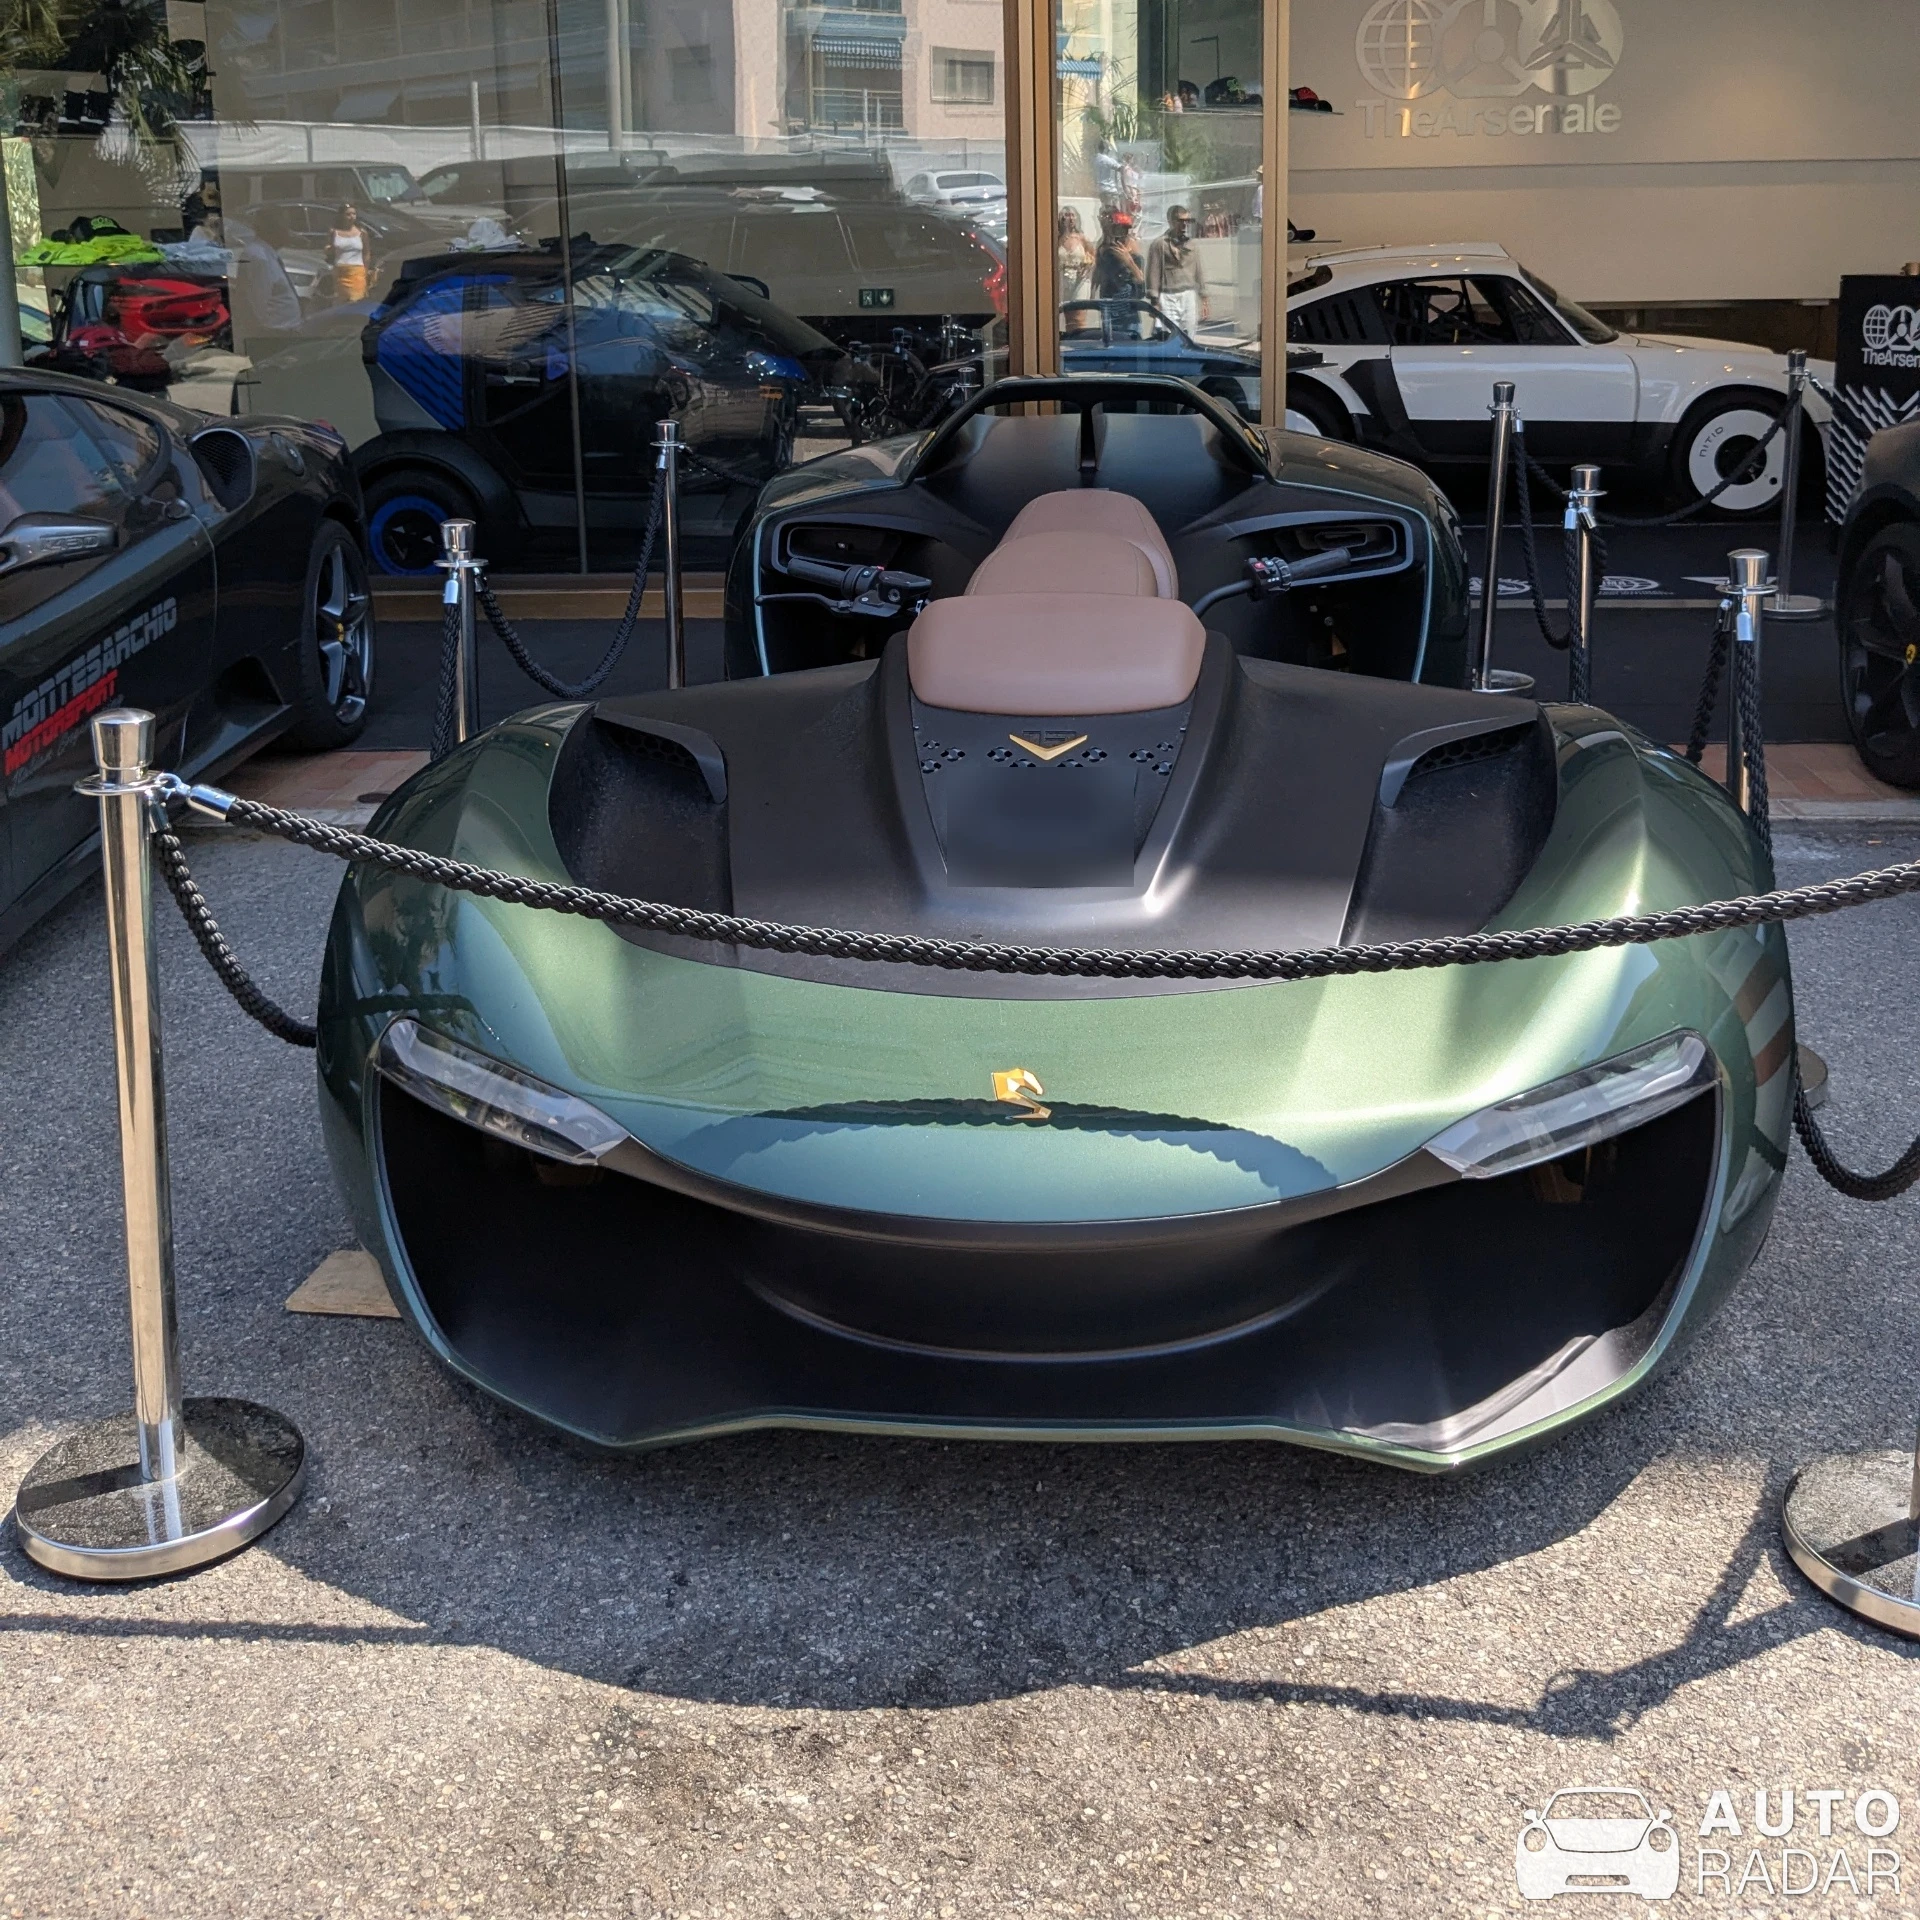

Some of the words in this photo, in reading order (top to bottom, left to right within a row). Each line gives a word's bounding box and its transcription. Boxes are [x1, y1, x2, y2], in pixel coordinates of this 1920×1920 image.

[1355, 95, 1622, 138] TheArsenale
[2, 597, 177, 750] MONTESARCHIO
[4, 669, 119, 777] MOTORSPORT
